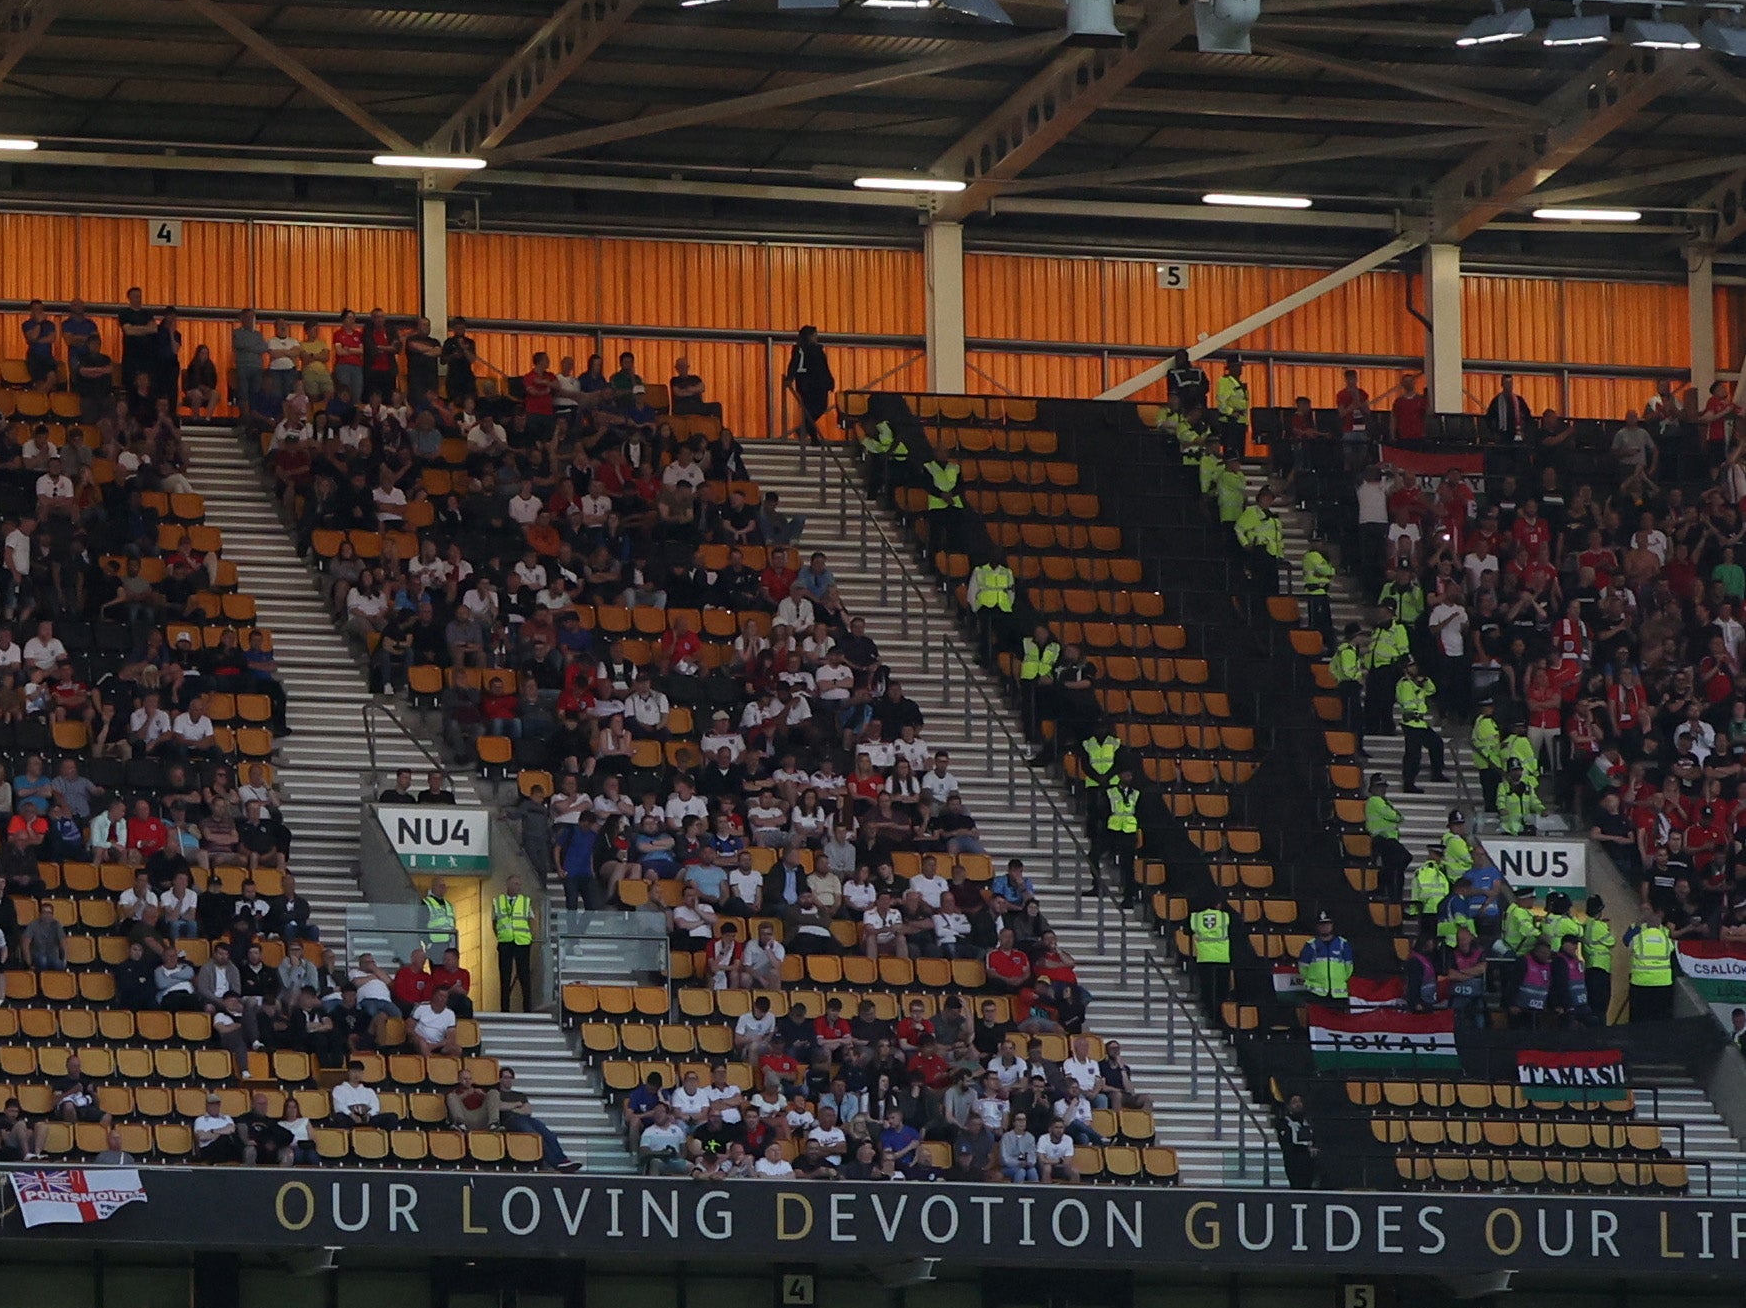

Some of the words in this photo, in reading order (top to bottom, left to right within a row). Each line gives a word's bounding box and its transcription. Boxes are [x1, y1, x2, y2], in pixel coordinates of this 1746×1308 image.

[157, 223, 171, 243] 4
[1167, 266, 1181, 286] 5
[397, 817, 471, 847] NU4
[1499, 849, 1569, 879] NU5
[275, 1181, 421, 1234] OUR
[463, 1185, 733, 1240] LOVING
[776, 1193, 1143, 1250] DEVOTION
[1184, 1201, 1446, 1255] GUIDES
[1485, 1207, 1621, 1258] OUR
[789, 1279, 805, 1301] 4
